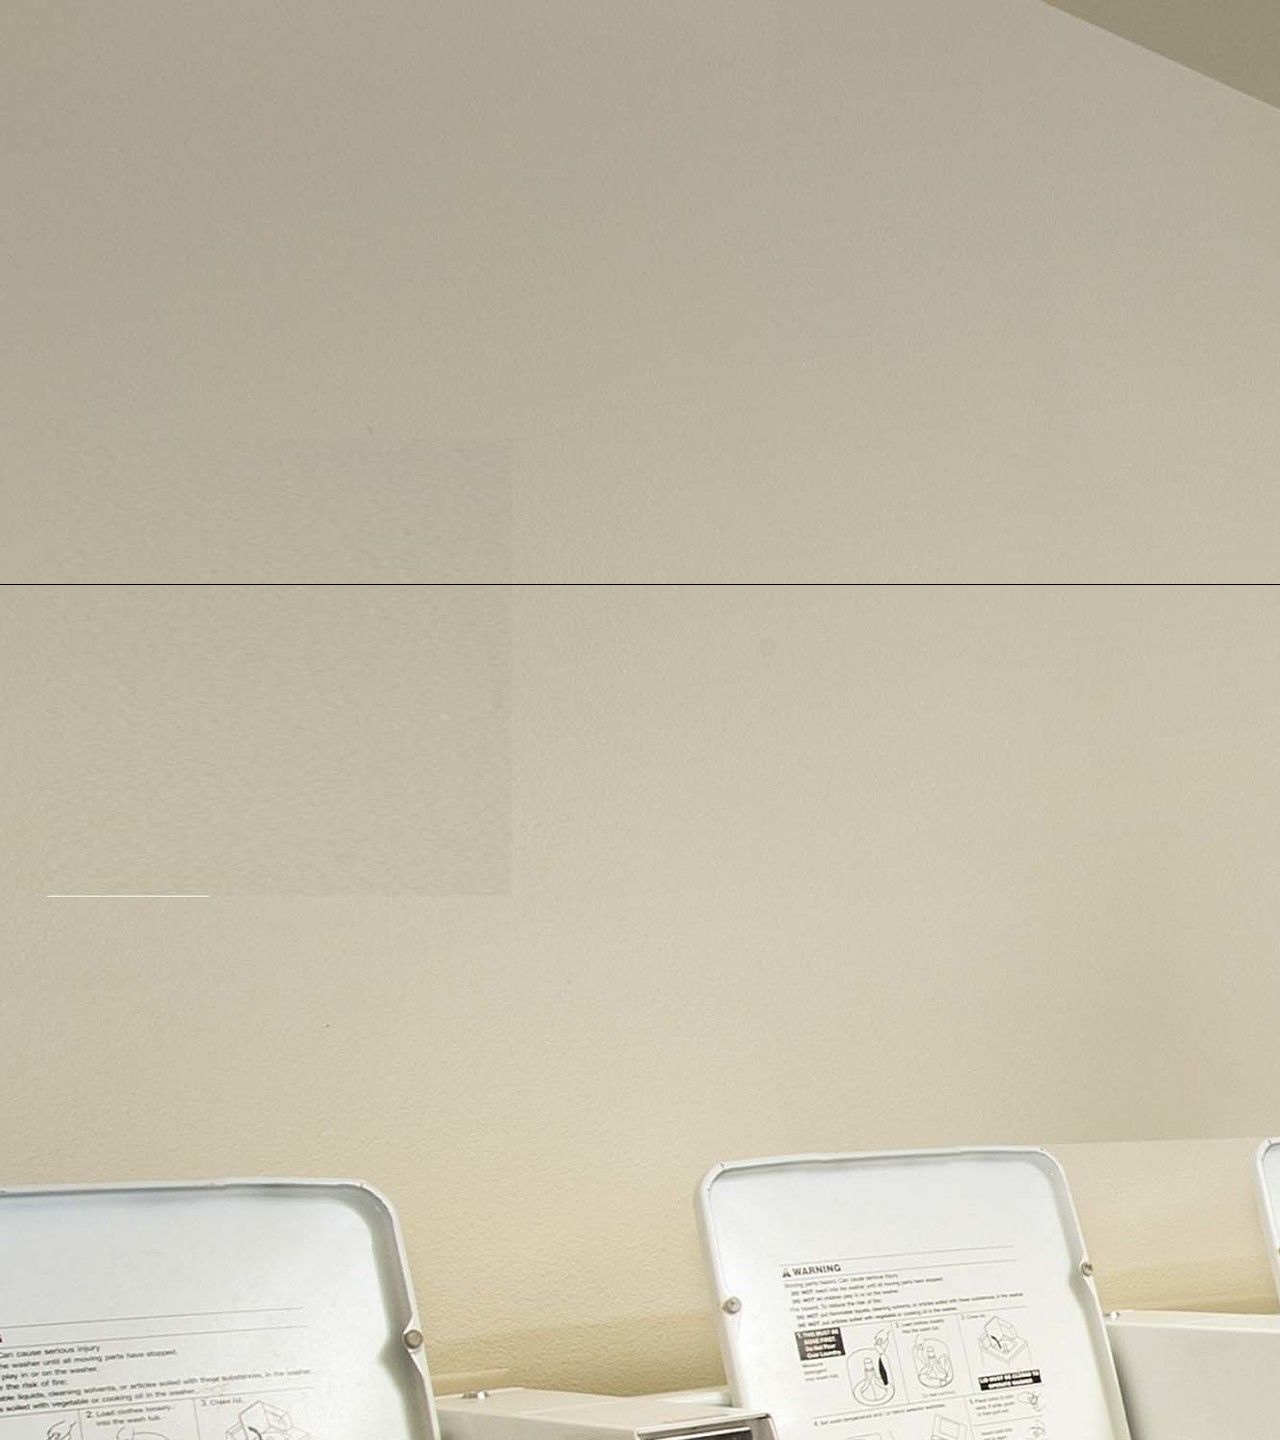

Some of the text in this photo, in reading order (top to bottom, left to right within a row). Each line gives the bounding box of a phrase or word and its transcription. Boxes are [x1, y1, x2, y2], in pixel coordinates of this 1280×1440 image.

[792, 1264, 841, 1276] WARNING
[16, 1350, 42, 1358] cause
[44, 1347, 75, 1356] serious
[77, 1345, 101, 1354] injury
[12, 1360, 40, 1369] washer
[54, 1367, 67, 1375] the
